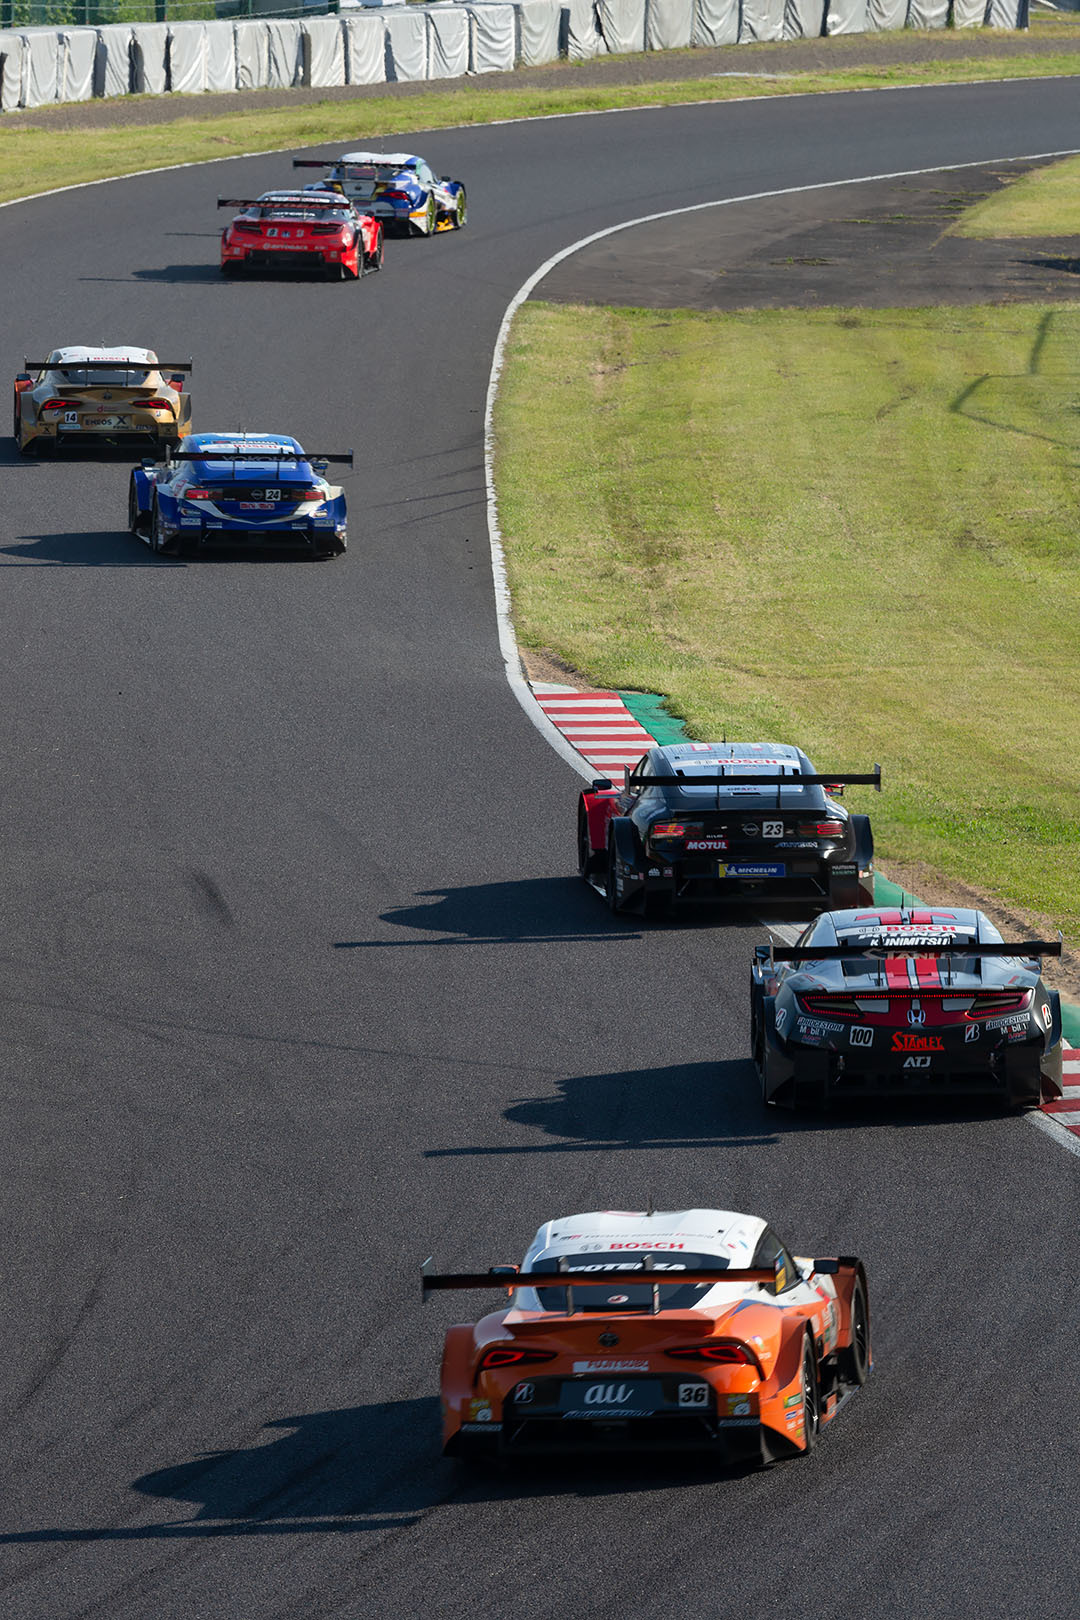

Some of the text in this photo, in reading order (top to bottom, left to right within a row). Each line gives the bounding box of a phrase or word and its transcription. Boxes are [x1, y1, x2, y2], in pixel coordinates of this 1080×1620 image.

[66, 413, 76, 422] 14
[267, 490, 280, 500] 24
[765, 824, 783, 836] 23
[686, 841, 728, 850] MOTUL
[886, 925, 957, 933] BOSCH
[851, 1028, 872, 1045] 100
[891, 1031, 945, 1052] STANLEY
[608, 1241, 685, 1251] BOSCH
[583, 1383, 635, 1405] au
[681, 1387, 706, 1404] 36
